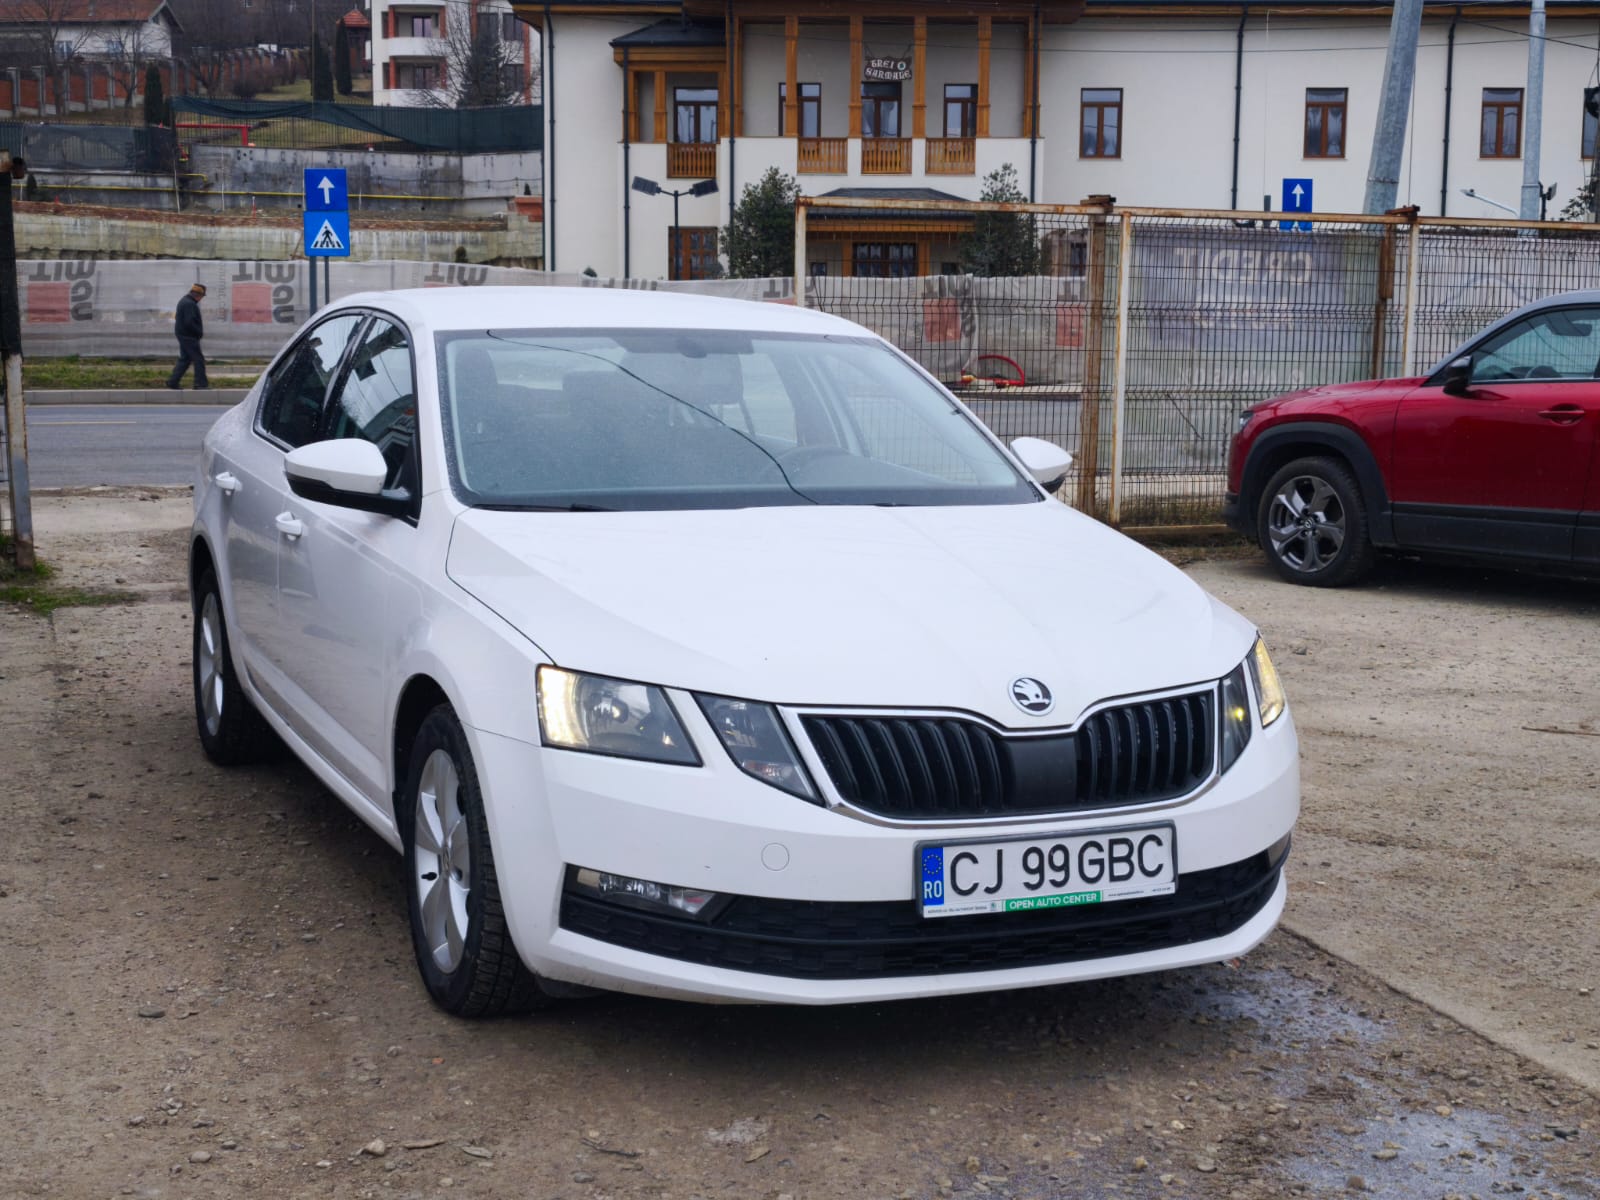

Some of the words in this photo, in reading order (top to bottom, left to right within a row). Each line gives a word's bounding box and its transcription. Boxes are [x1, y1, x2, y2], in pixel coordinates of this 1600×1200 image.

[949, 848, 1004, 897] CJ
[923, 880, 943, 899] RO
[1009, 900, 1034, 910] OPEN
[1036, 897, 1061, 907] AUTO
[1063, 892, 1097, 904] CENTER
